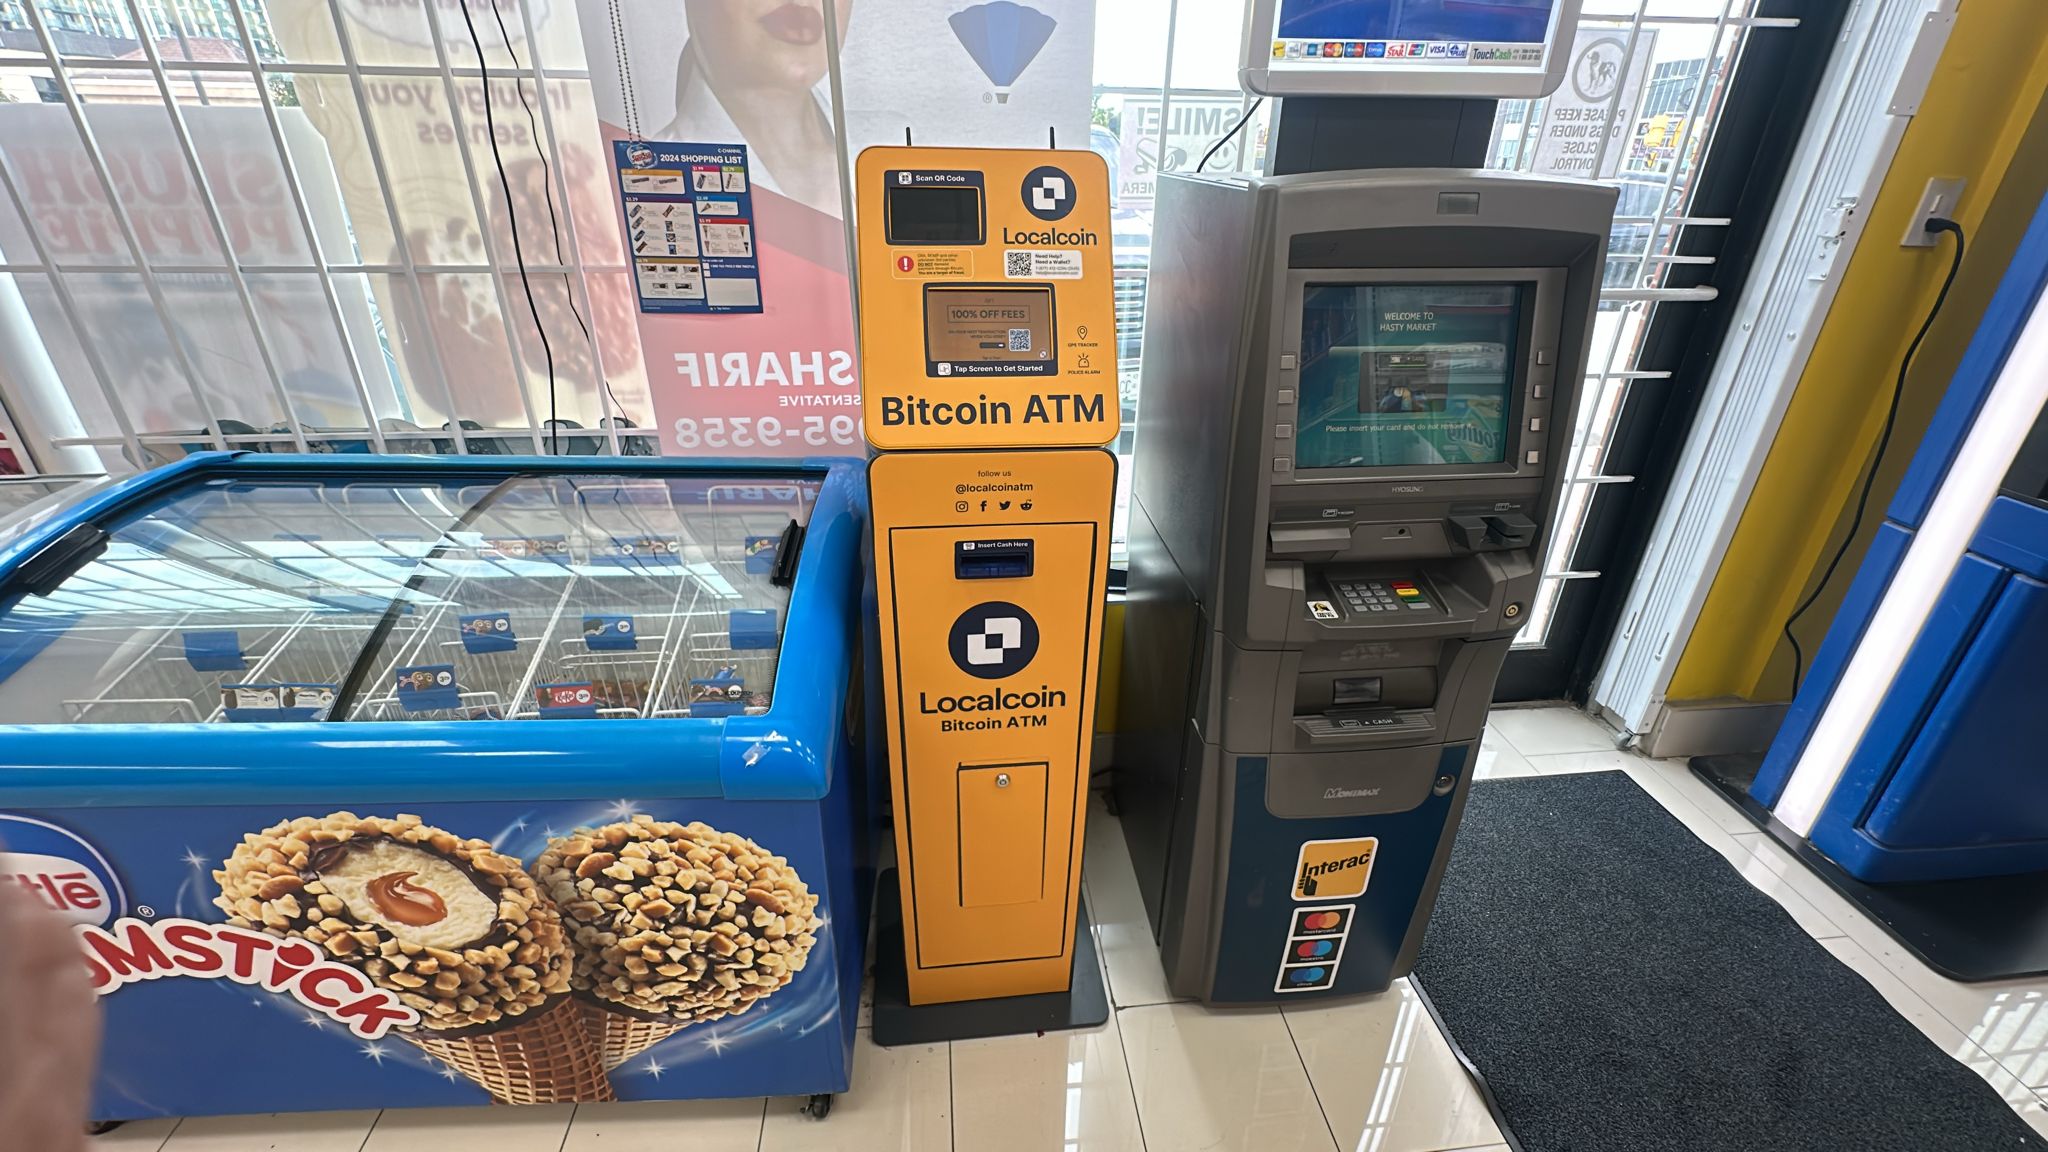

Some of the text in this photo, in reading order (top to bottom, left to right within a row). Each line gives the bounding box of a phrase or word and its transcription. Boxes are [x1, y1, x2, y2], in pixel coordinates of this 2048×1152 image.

[1429, 45, 1446, 54] VISA
[1473, 48, 1512, 60] TouchCash
[660, 154, 680, 162] 2024
[680, 155, 724, 164] SHOPPING
[724, 156, 742, 164] LIST
[934, 175, 945, 183] QR
[1003, 227, 1098, 246] Localcoin
[951, 309, 1025, 319] 100% OFF FEES
[1384, 311, 1434, 321] WELCOME TO
[1380, 323, 1437, 332] HASTY MARKET
[954, 365, 968, 374] Tap
[1003, 364, 1015, 372] Get
[1016, 364, 1043, 372] Started
[881, 393, 1105, 427] Bitcoin ATM
[1325, 424, 1347, 433] Please
[1349, 424, 1368, 432] insert
[1370, 425, 1386, 434] your
[1386, 423, 1402, 432] card
[1403, 423, 1416, 431] and
[1417, 423, 1426, 431] do
[1428, 423, 1439, 431] not
[955, 482, 1033, 494] @localcoinatm
[920, 685, 1066, 714] Localcoin
[941, 715, 1047, 732] Bitcoin ATM
[1302, 852, 1371, 878] Interac
